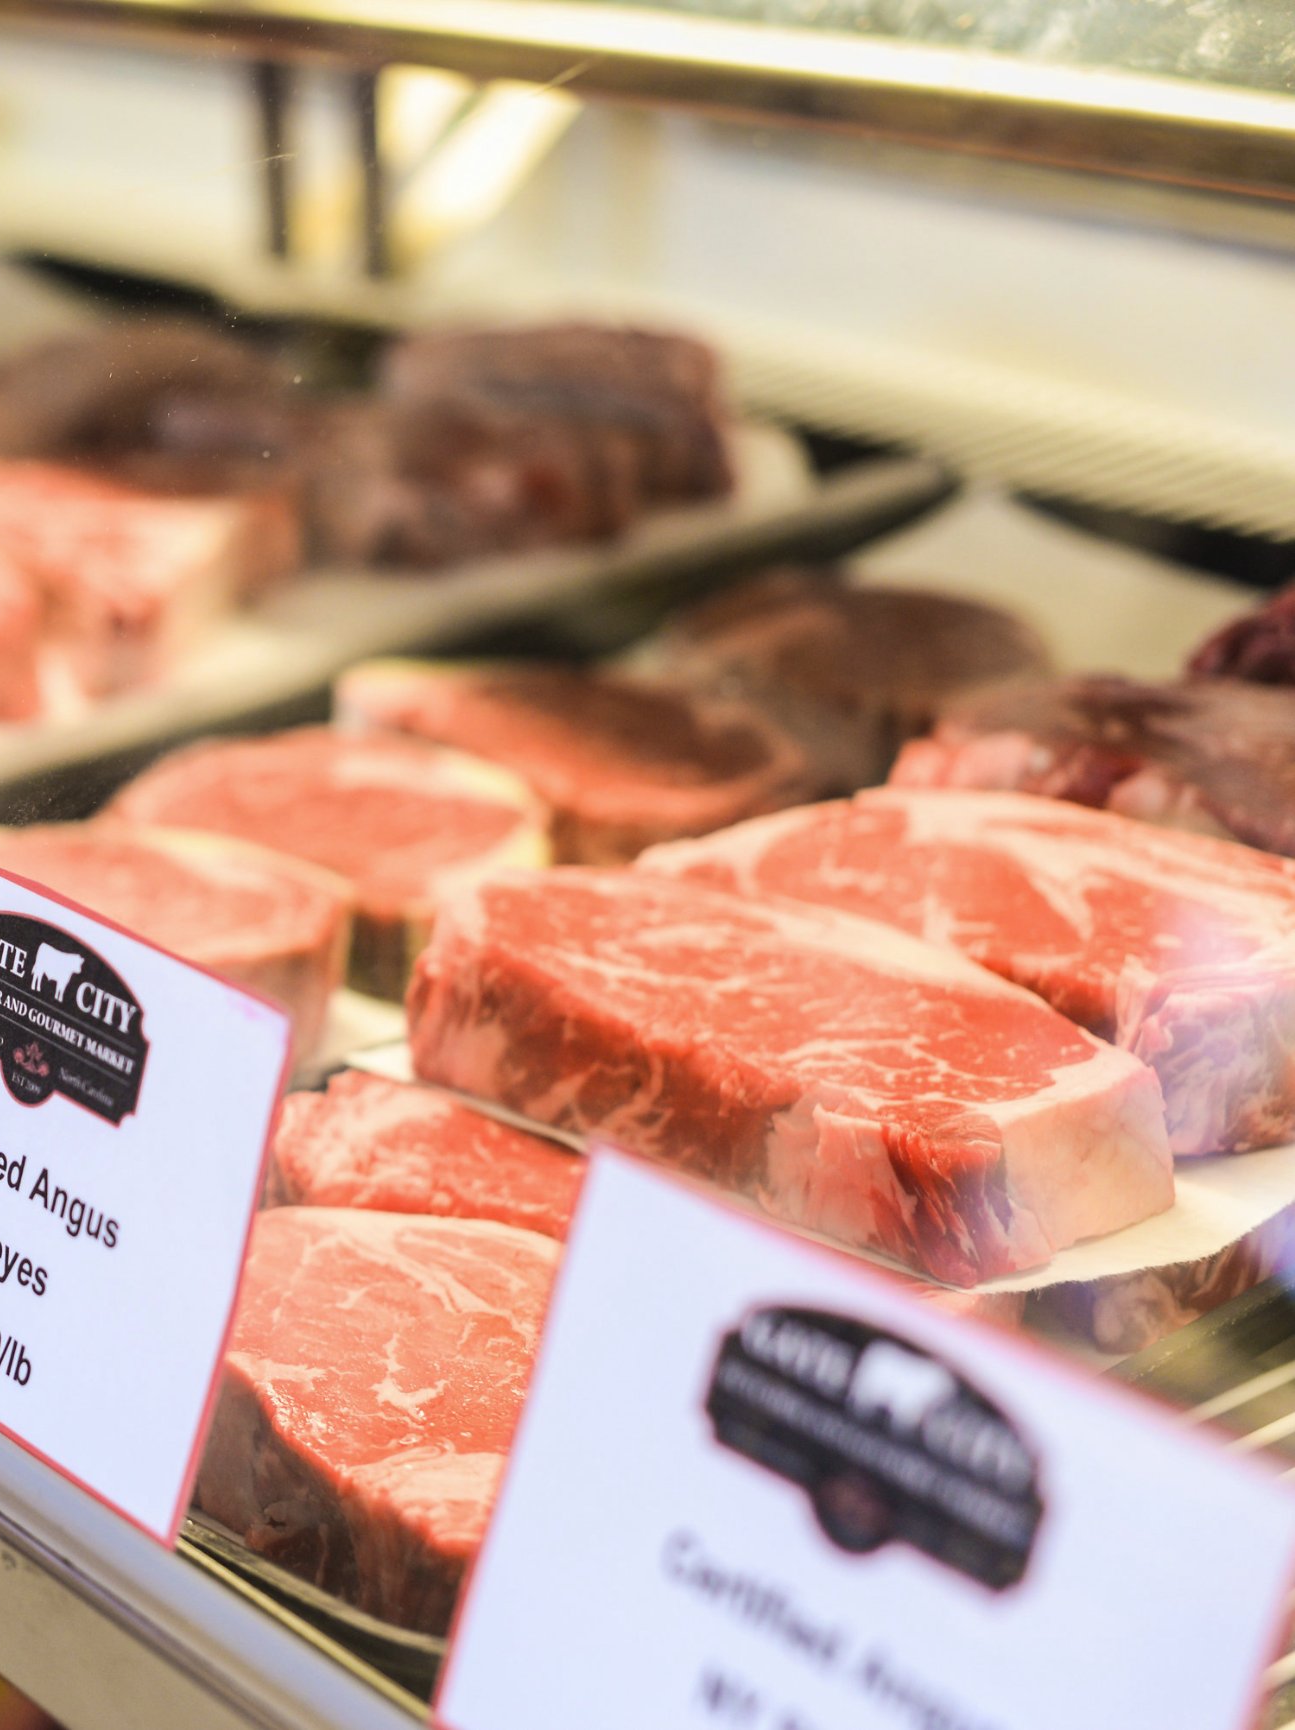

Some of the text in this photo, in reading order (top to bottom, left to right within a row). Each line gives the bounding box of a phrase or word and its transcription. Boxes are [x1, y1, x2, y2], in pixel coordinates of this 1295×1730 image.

[3, 994, 28, 1017] AND
[28, 1007, 85, 1047] GOURMET
[84, 1039, 136, 1075] MARKET
[76, 982, 137, 1034] CITY
[28, 1167, 120, 1249] Angus
